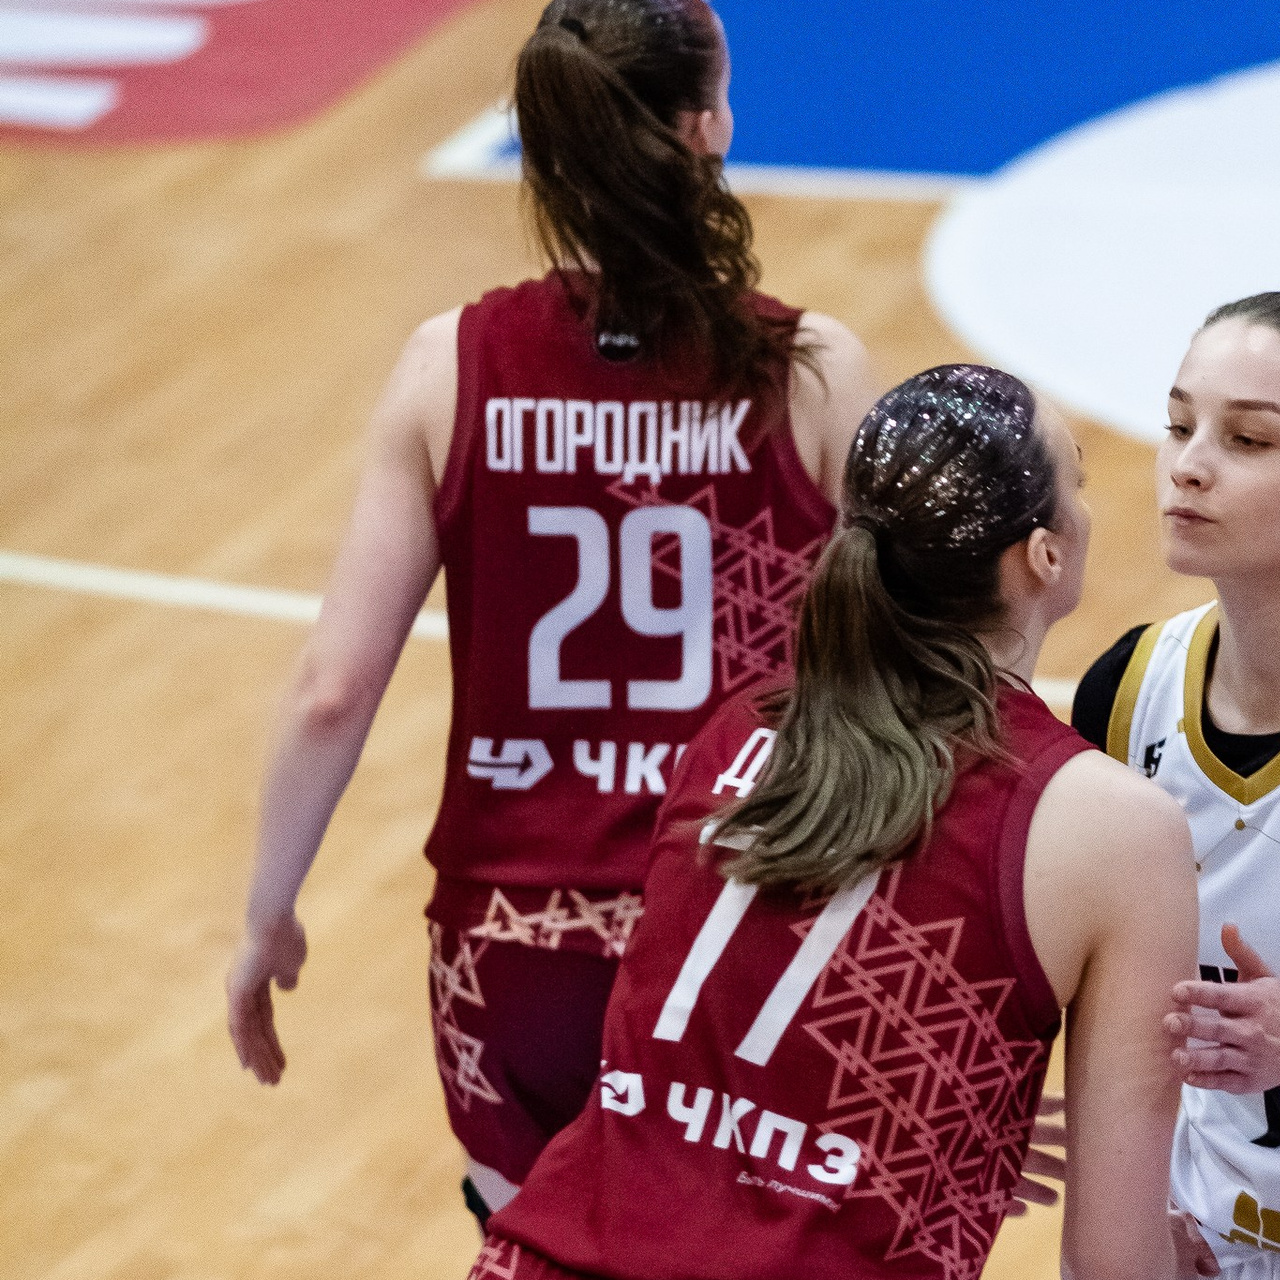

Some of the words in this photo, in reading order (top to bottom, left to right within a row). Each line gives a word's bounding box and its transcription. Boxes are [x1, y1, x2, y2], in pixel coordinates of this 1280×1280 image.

[486, 397, 752, 484] ОГОРОДНИК
[527, 506, 714, 710] 29
[572, 738, 688, 795] ЧК
[667, 1081, 862, 1186] ЧКПЗ
